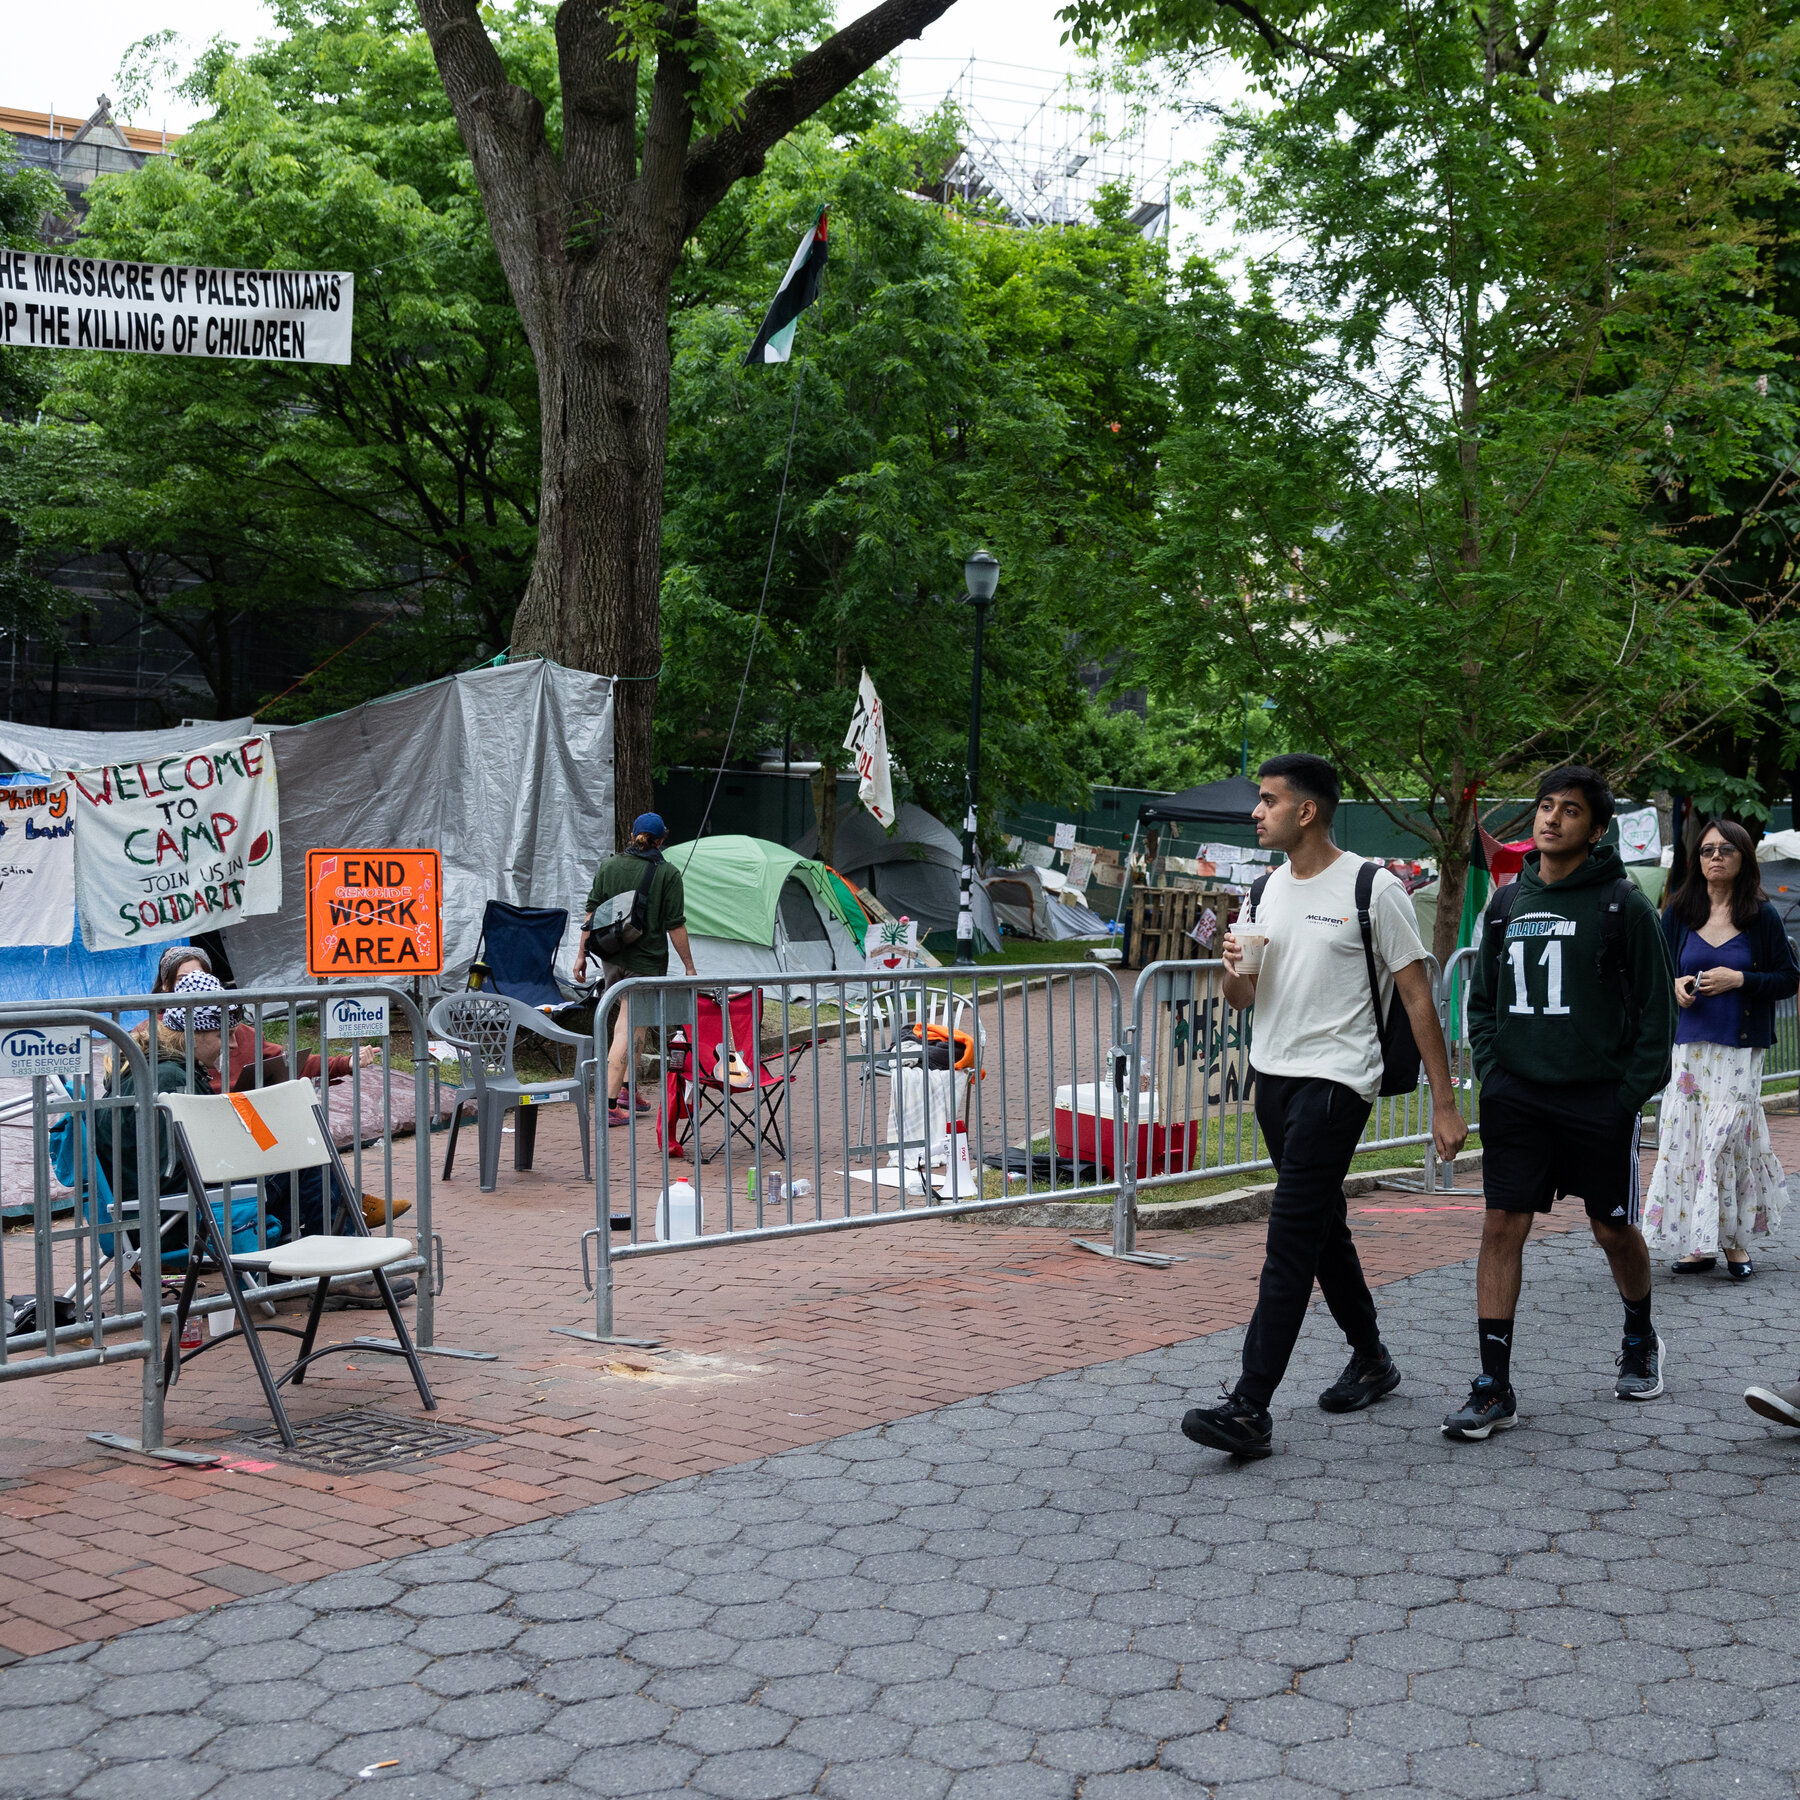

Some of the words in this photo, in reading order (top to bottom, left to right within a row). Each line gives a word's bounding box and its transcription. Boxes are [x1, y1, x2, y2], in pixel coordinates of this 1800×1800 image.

[34, 254, 154, 301] MASSACRE
[160, 266, 188, 303] OF
[195, 268, 341, 312] PALESTINIANS
[0, 302, 18, 342] P
[25, 303, 70, 346] THE
[78, 307, 165, 352] KILLING
[172, 314, 198, 353] OF
[205, 316, 305, 359] CHILDREN
[67, 738, 263, 807] WELCOME
[156, 798, 198, 825] TO
[125, 812, 238, 866] CAMP
[139, 871, 190, 893] JOIN
[200, 863, 224, 882] US
[228, 856, 244, 875] IN
[344, 861, 405, 887] END
[335, 886, 412, 899] GENOCIDE
[119, 879, 245, 936] SOLIDARIT
[329, 899, 418, 926] WORK
[1305, 914, 1343, 925] McLaren
[331, 937, 420, 964] AREA
[1507, 940, 1570, 1015] 11
[338, 1006, 383, 1022] United
[10, 1037, 81, 1057] United
[11, 1060, 33, 1068] SITE
[35, 1057, 81, 1067] SERVICES
